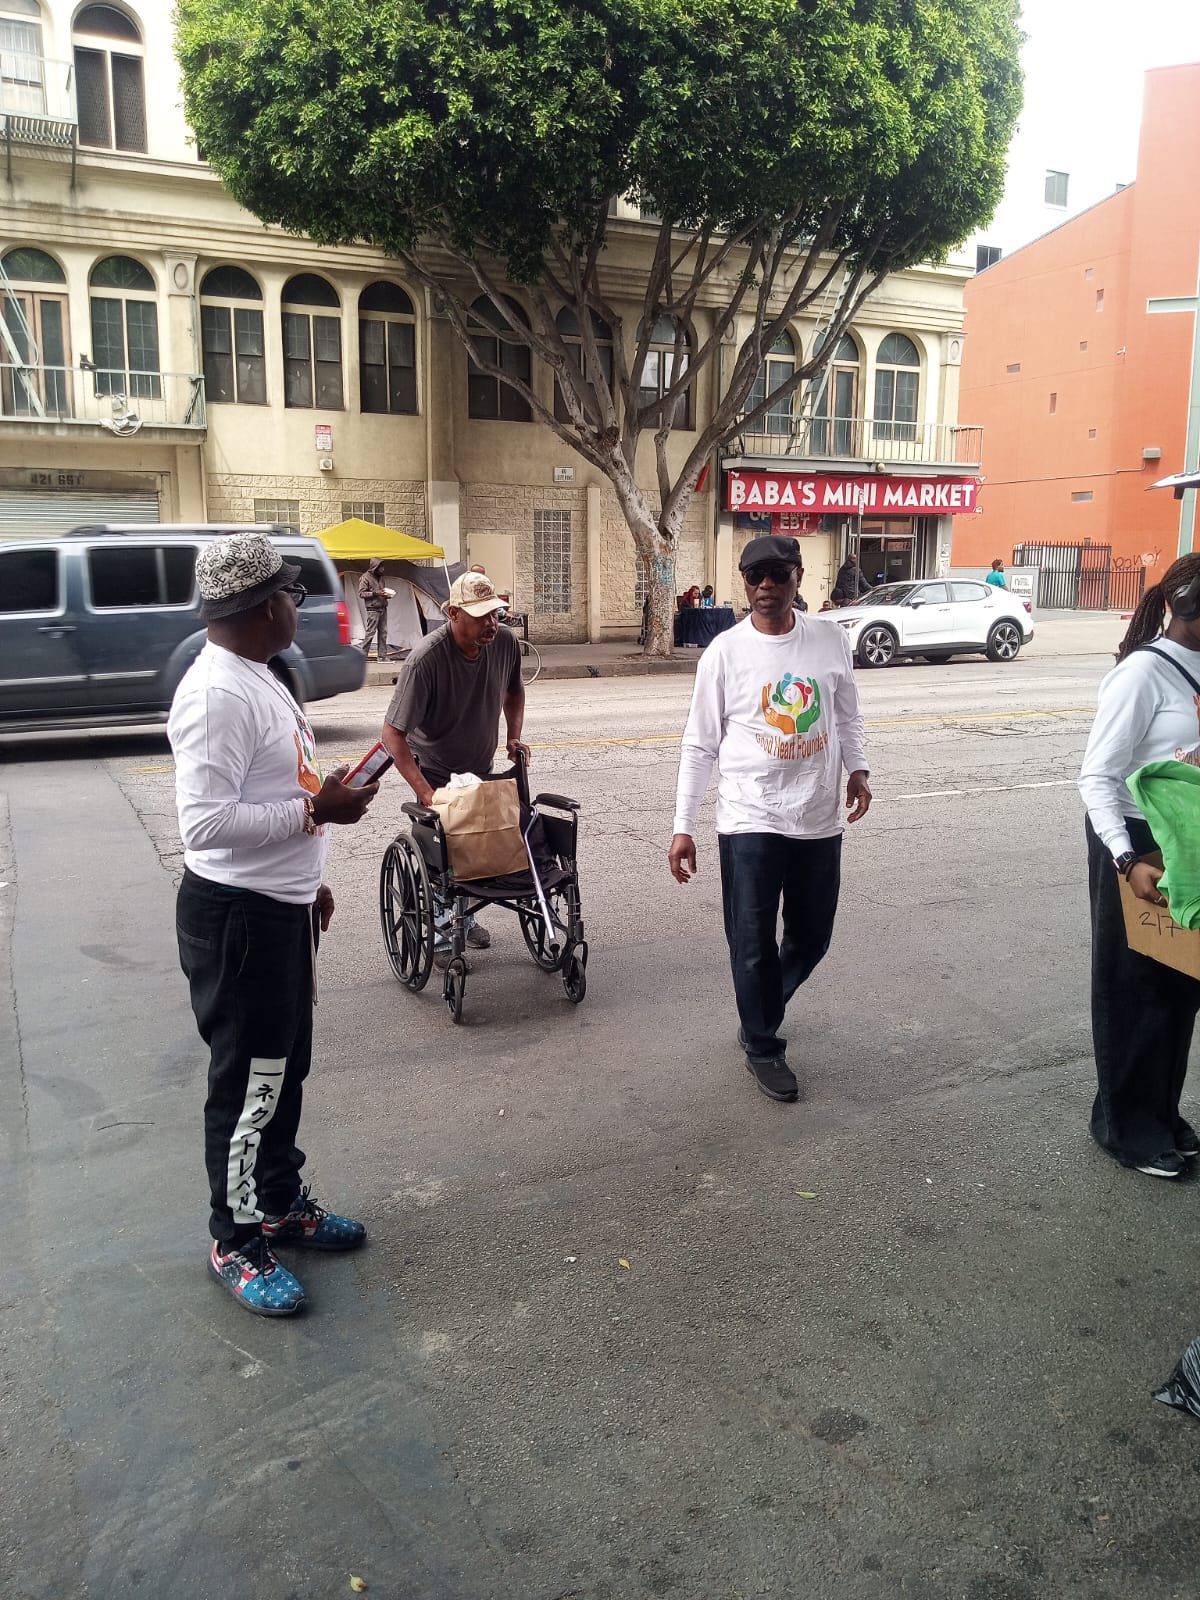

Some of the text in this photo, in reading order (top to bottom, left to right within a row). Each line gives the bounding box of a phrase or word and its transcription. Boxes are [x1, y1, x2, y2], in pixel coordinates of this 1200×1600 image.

[731, 480, 815, 505] BABA'S
[823, 483, 877, 506] MINI
[883, 484, 974, 507] MARKET
[780, 516, 810, 530] EBT
[756, 733, 774, 754] Good
[773, 735, 795, 760] Heart
